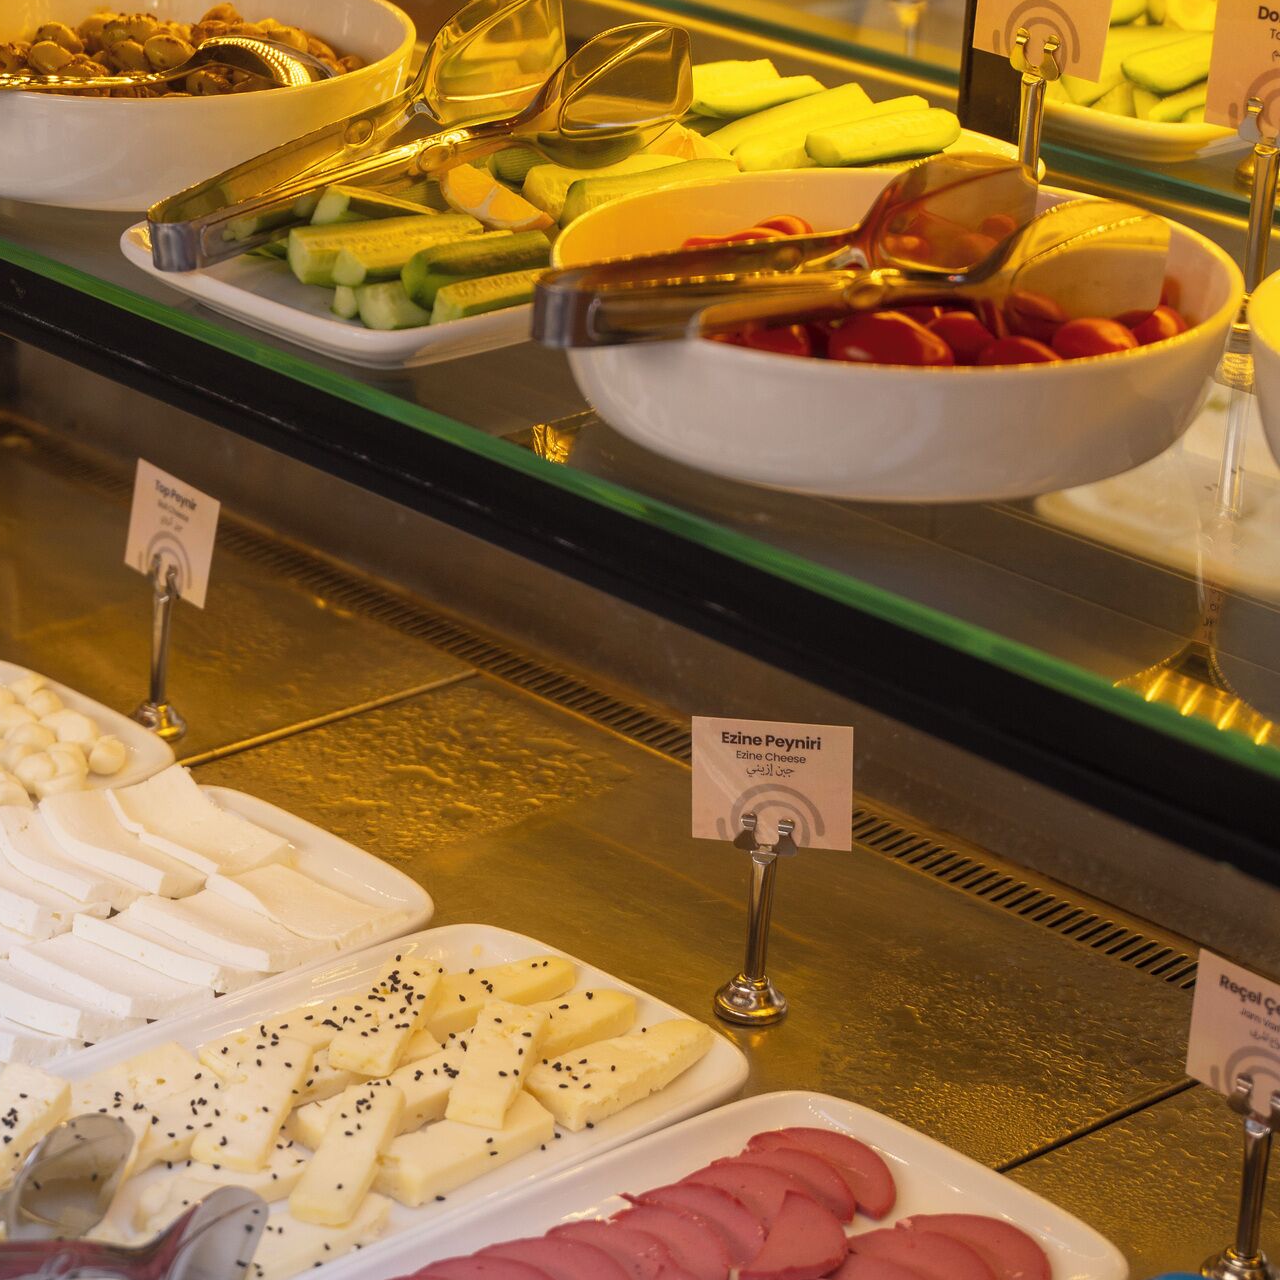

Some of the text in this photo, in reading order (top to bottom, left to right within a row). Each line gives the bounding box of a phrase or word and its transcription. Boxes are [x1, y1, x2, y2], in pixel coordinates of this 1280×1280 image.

[1258, 5, 1280, 23] Do
[721, 731, 822, 752] Ezine Peyniri
[736, 750, 806, 764] Ezine Cheese
[775, 765, 795, 778] جبن
[1219, 974, 1262, 1006] Reçel
